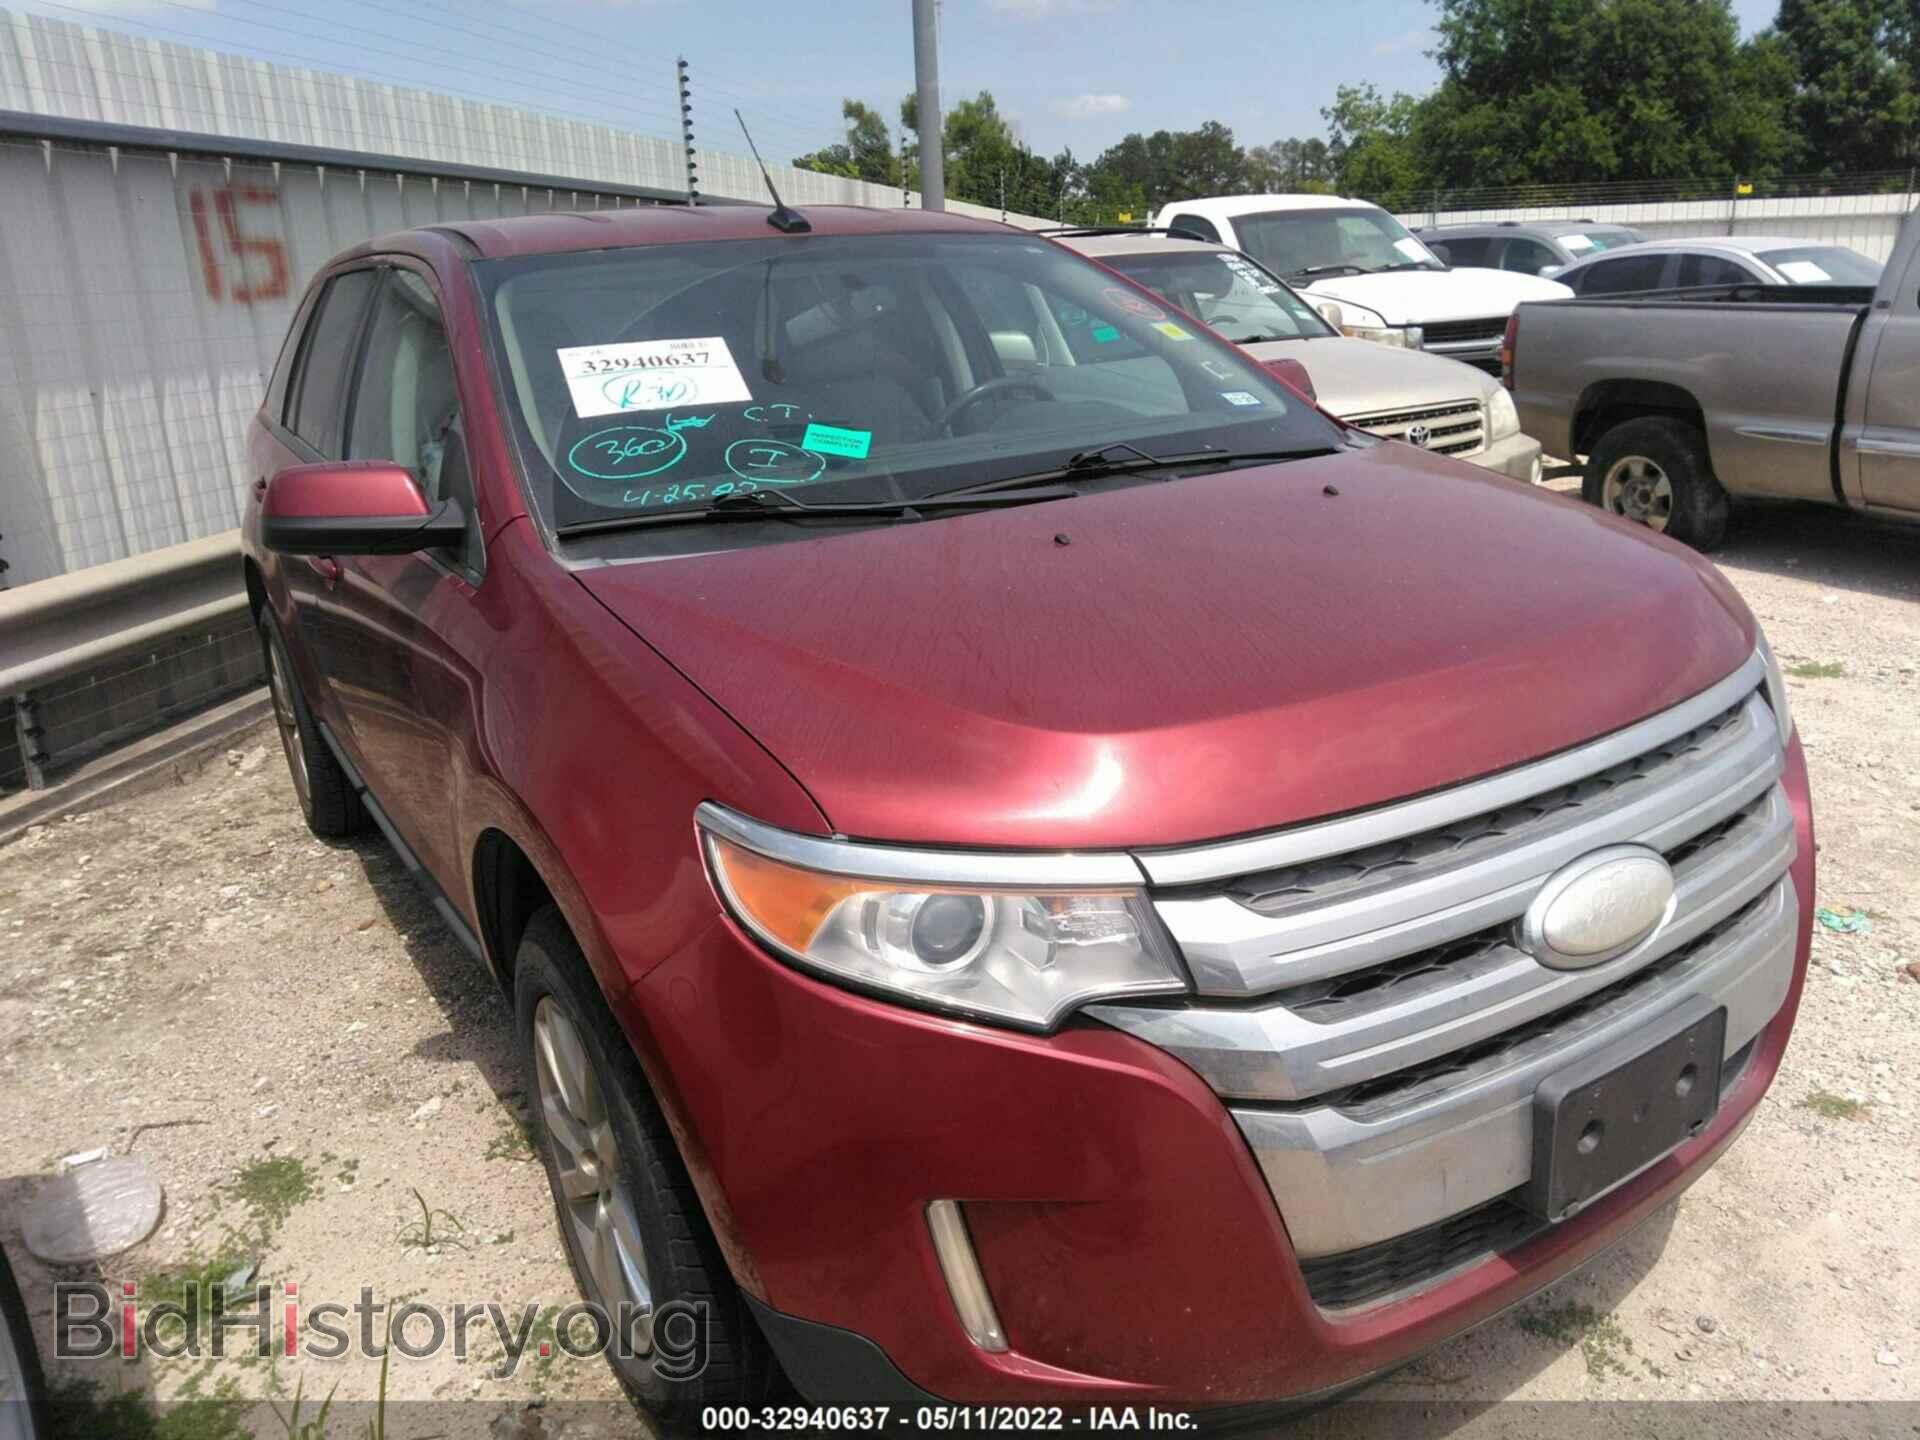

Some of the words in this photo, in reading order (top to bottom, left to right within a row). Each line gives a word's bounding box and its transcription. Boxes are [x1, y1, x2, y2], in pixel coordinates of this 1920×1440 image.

[187, 184, 289, 304] 15
[582, 351, 710, 375] 32940637
[595, 436, 666, 465] 360
